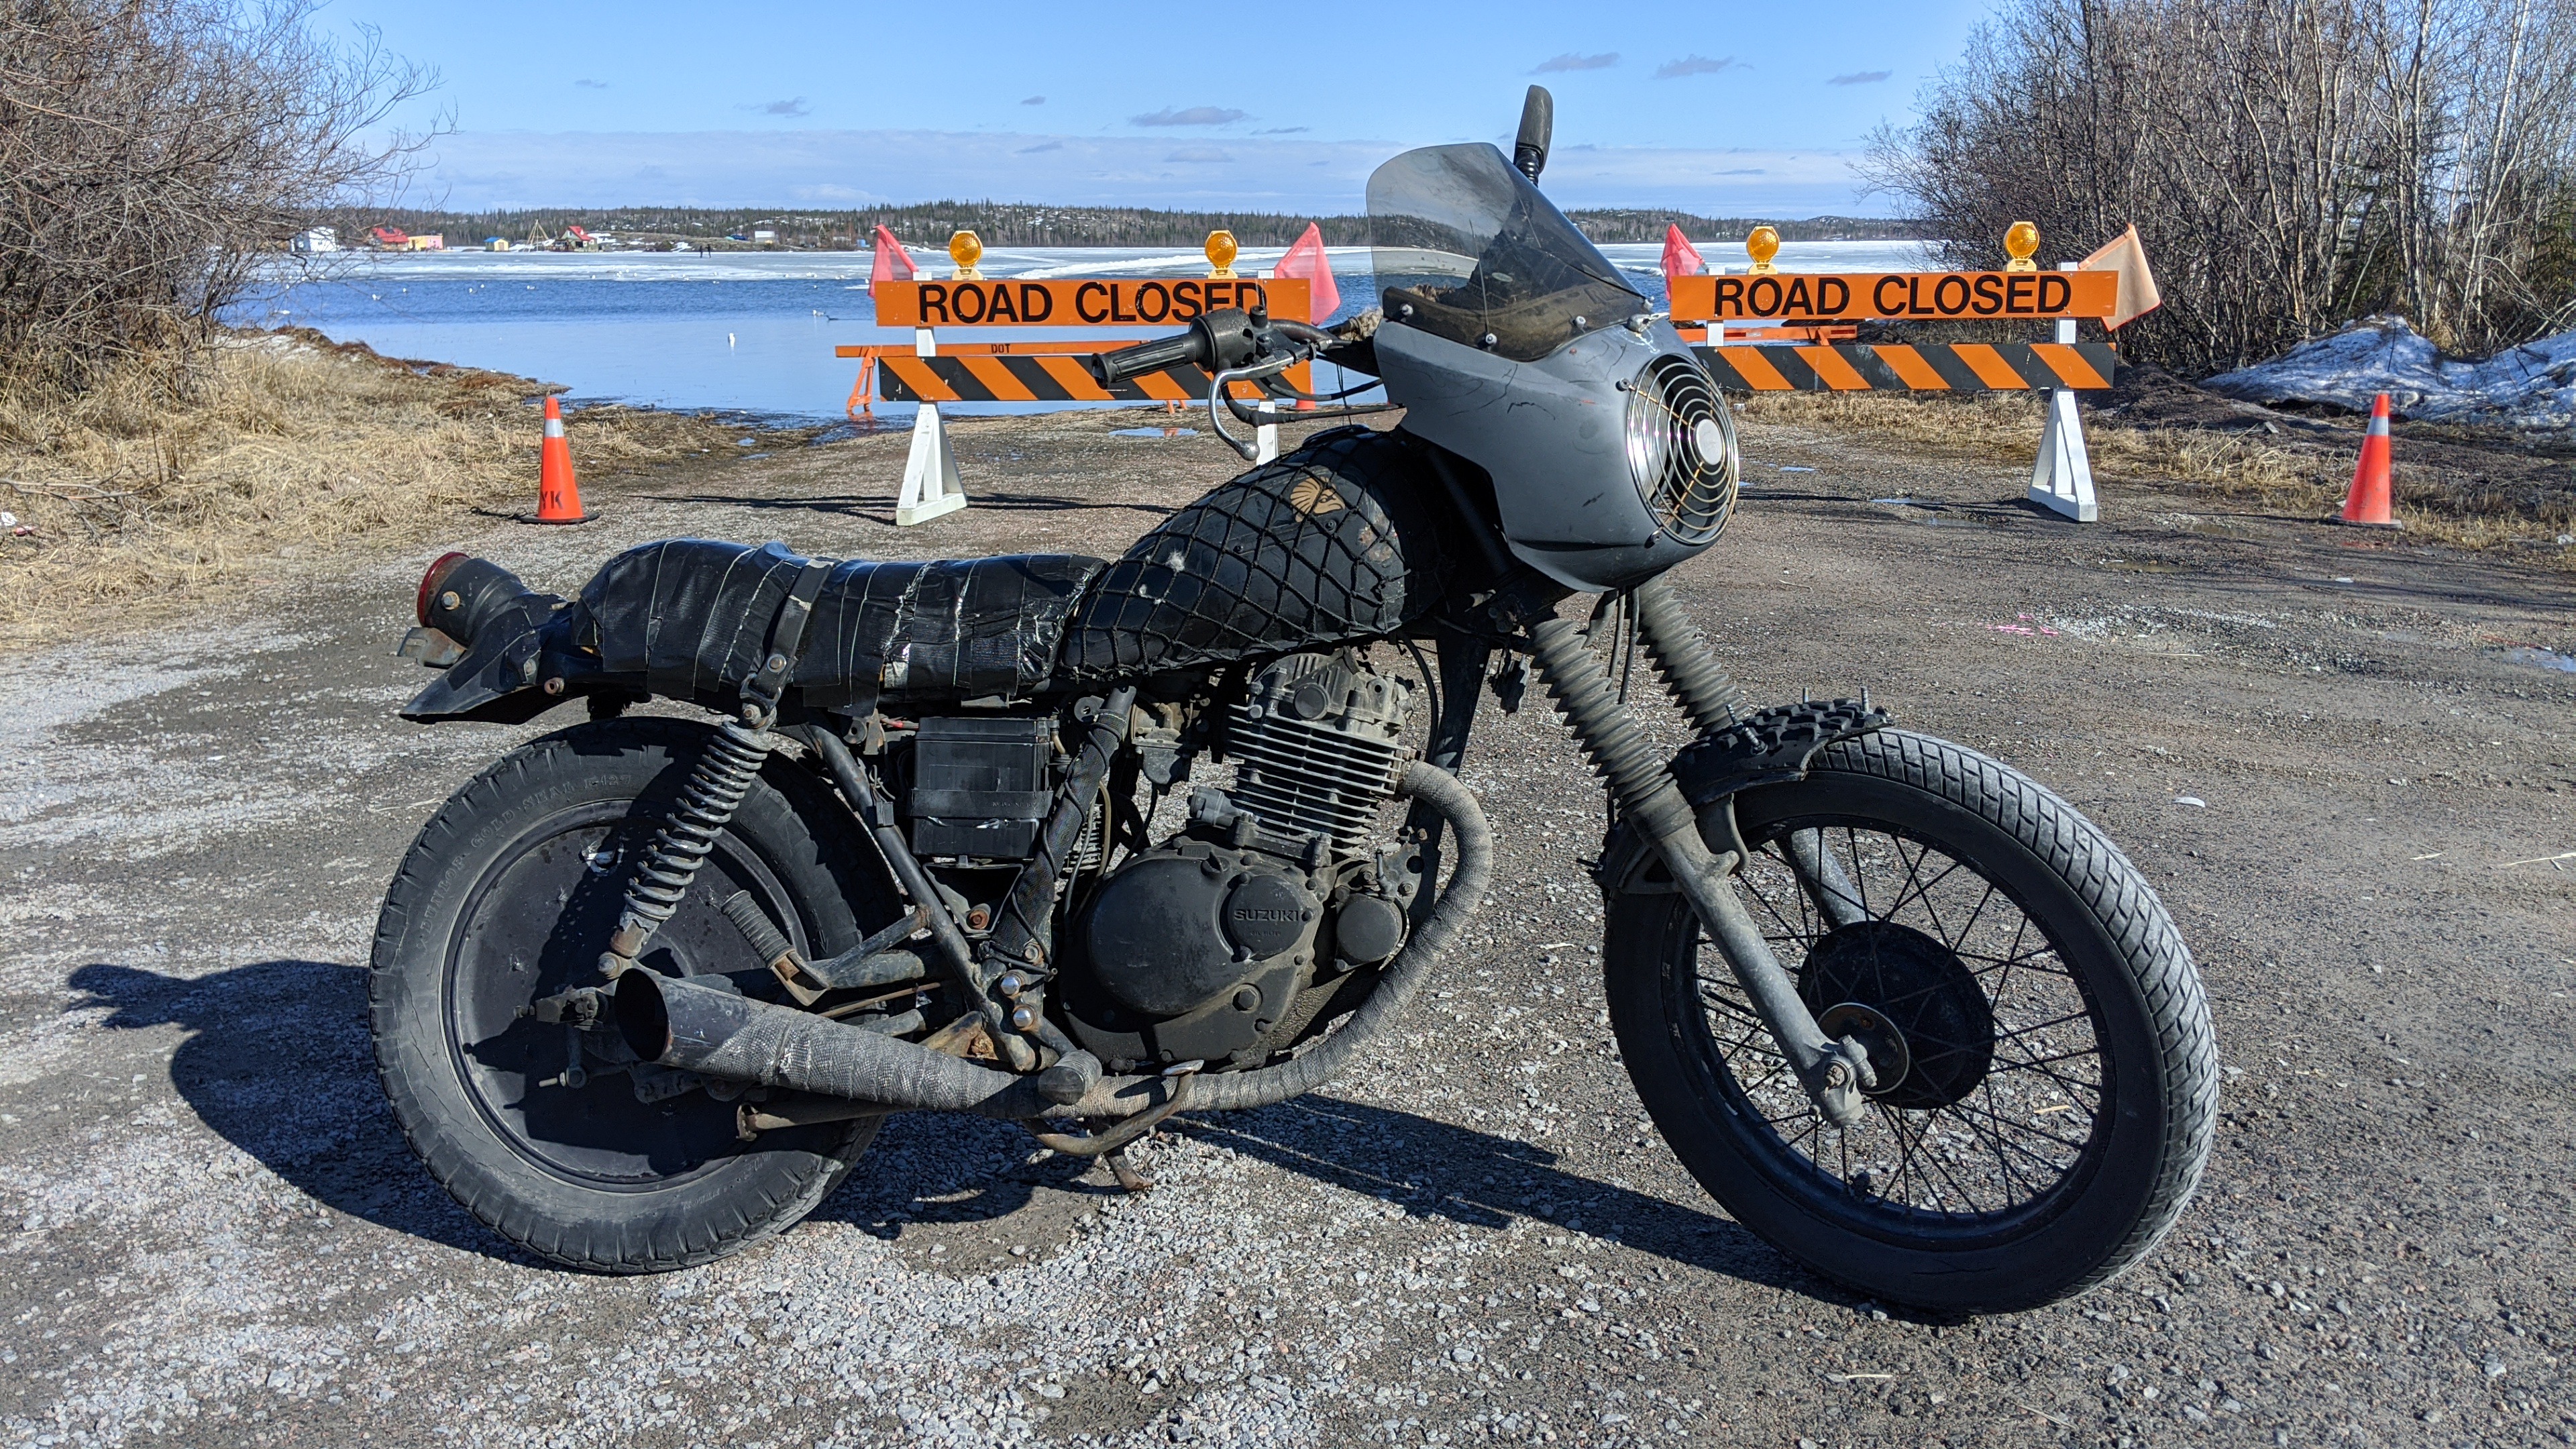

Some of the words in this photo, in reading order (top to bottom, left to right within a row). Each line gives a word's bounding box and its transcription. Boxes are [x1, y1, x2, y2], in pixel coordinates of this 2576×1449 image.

[918, 283, 1053, 324] ROAD
[1075, 281, 1267, 323] CLOSED
[1714, 277, 1850, 317] ROAD
[1873, 274, 2072, 316] CLOSED
[991, 343, 1010, 354] DOT
[541, 490, 564, 510] YK
[420, 855, 466, 934] DUNLOP
[470, 809, 515, 848] GOLD
[522, 781, 575, 807] SEAL
[1234, 908, 1299, 922] SUZUKI
